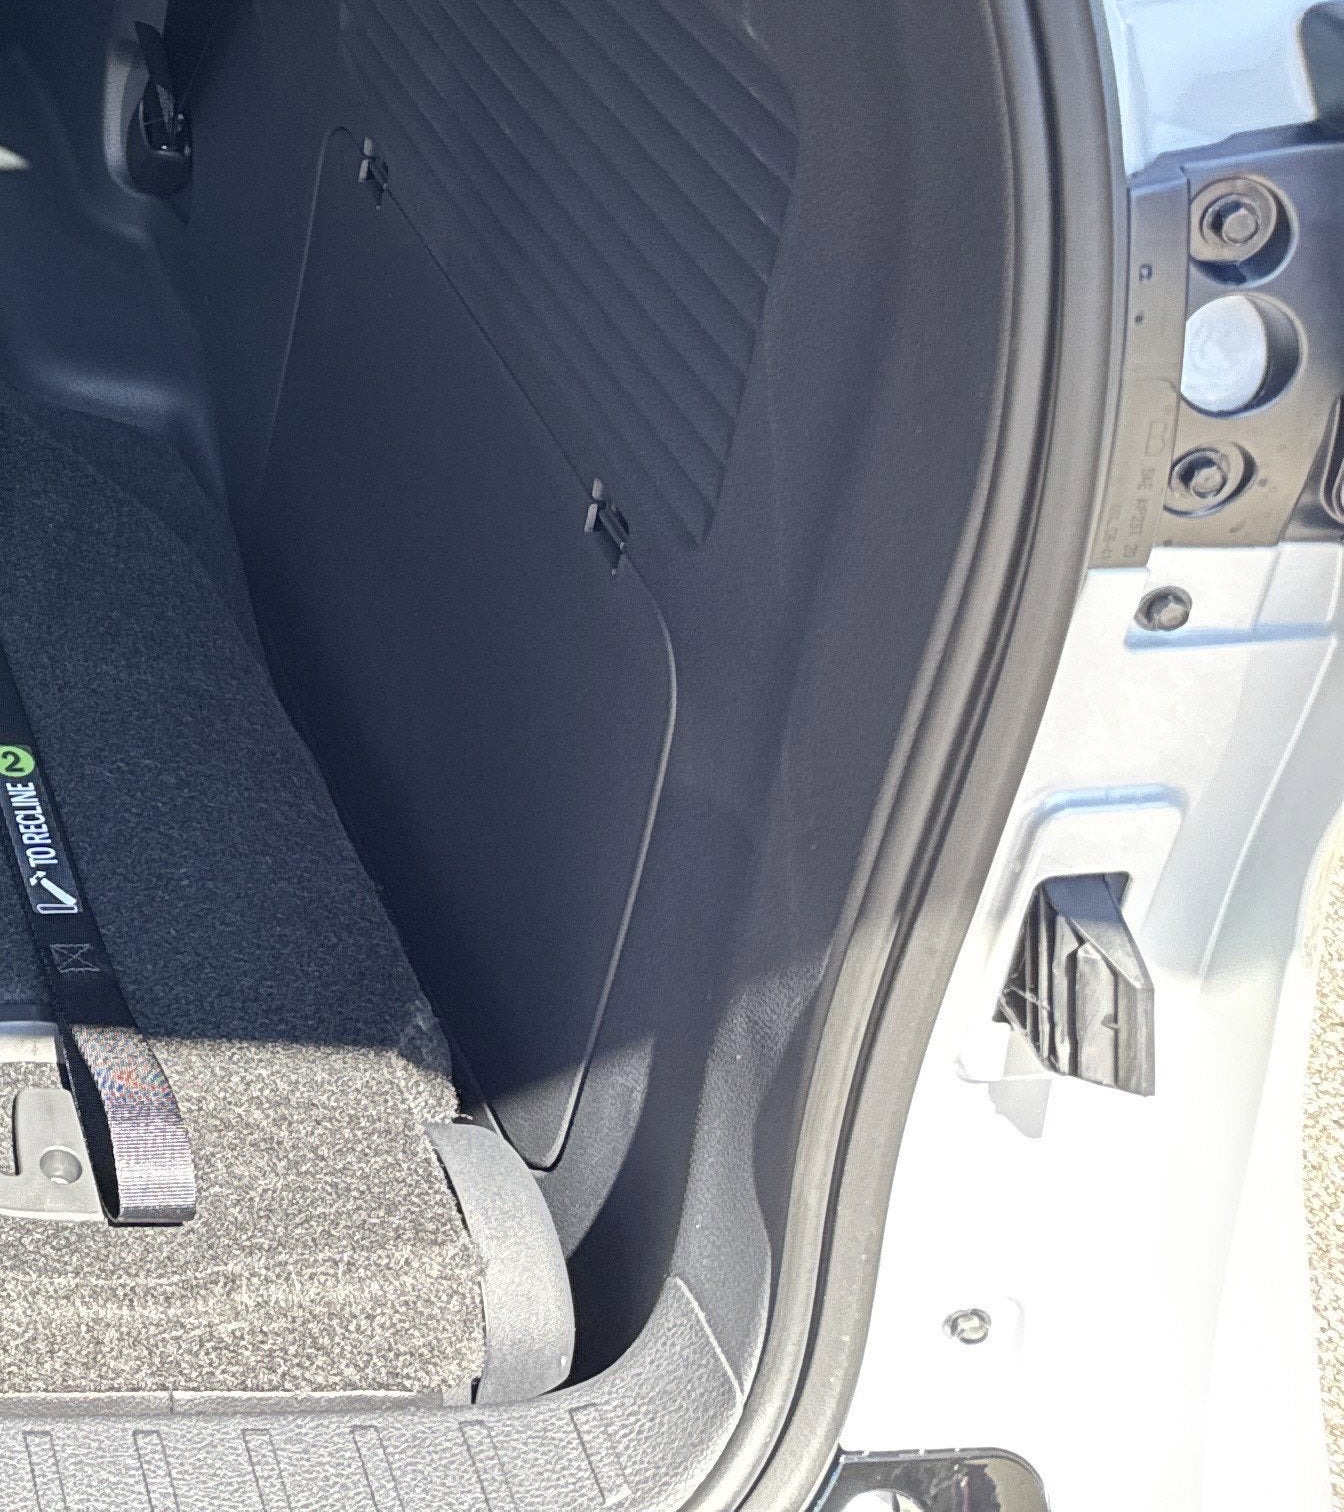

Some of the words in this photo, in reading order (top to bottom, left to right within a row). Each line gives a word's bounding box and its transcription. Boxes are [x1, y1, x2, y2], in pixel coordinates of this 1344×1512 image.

[1, 751, 25, 772] 2
[6, 782, 51, 844] RECLINE
[26, 847, 58, 868] TO
